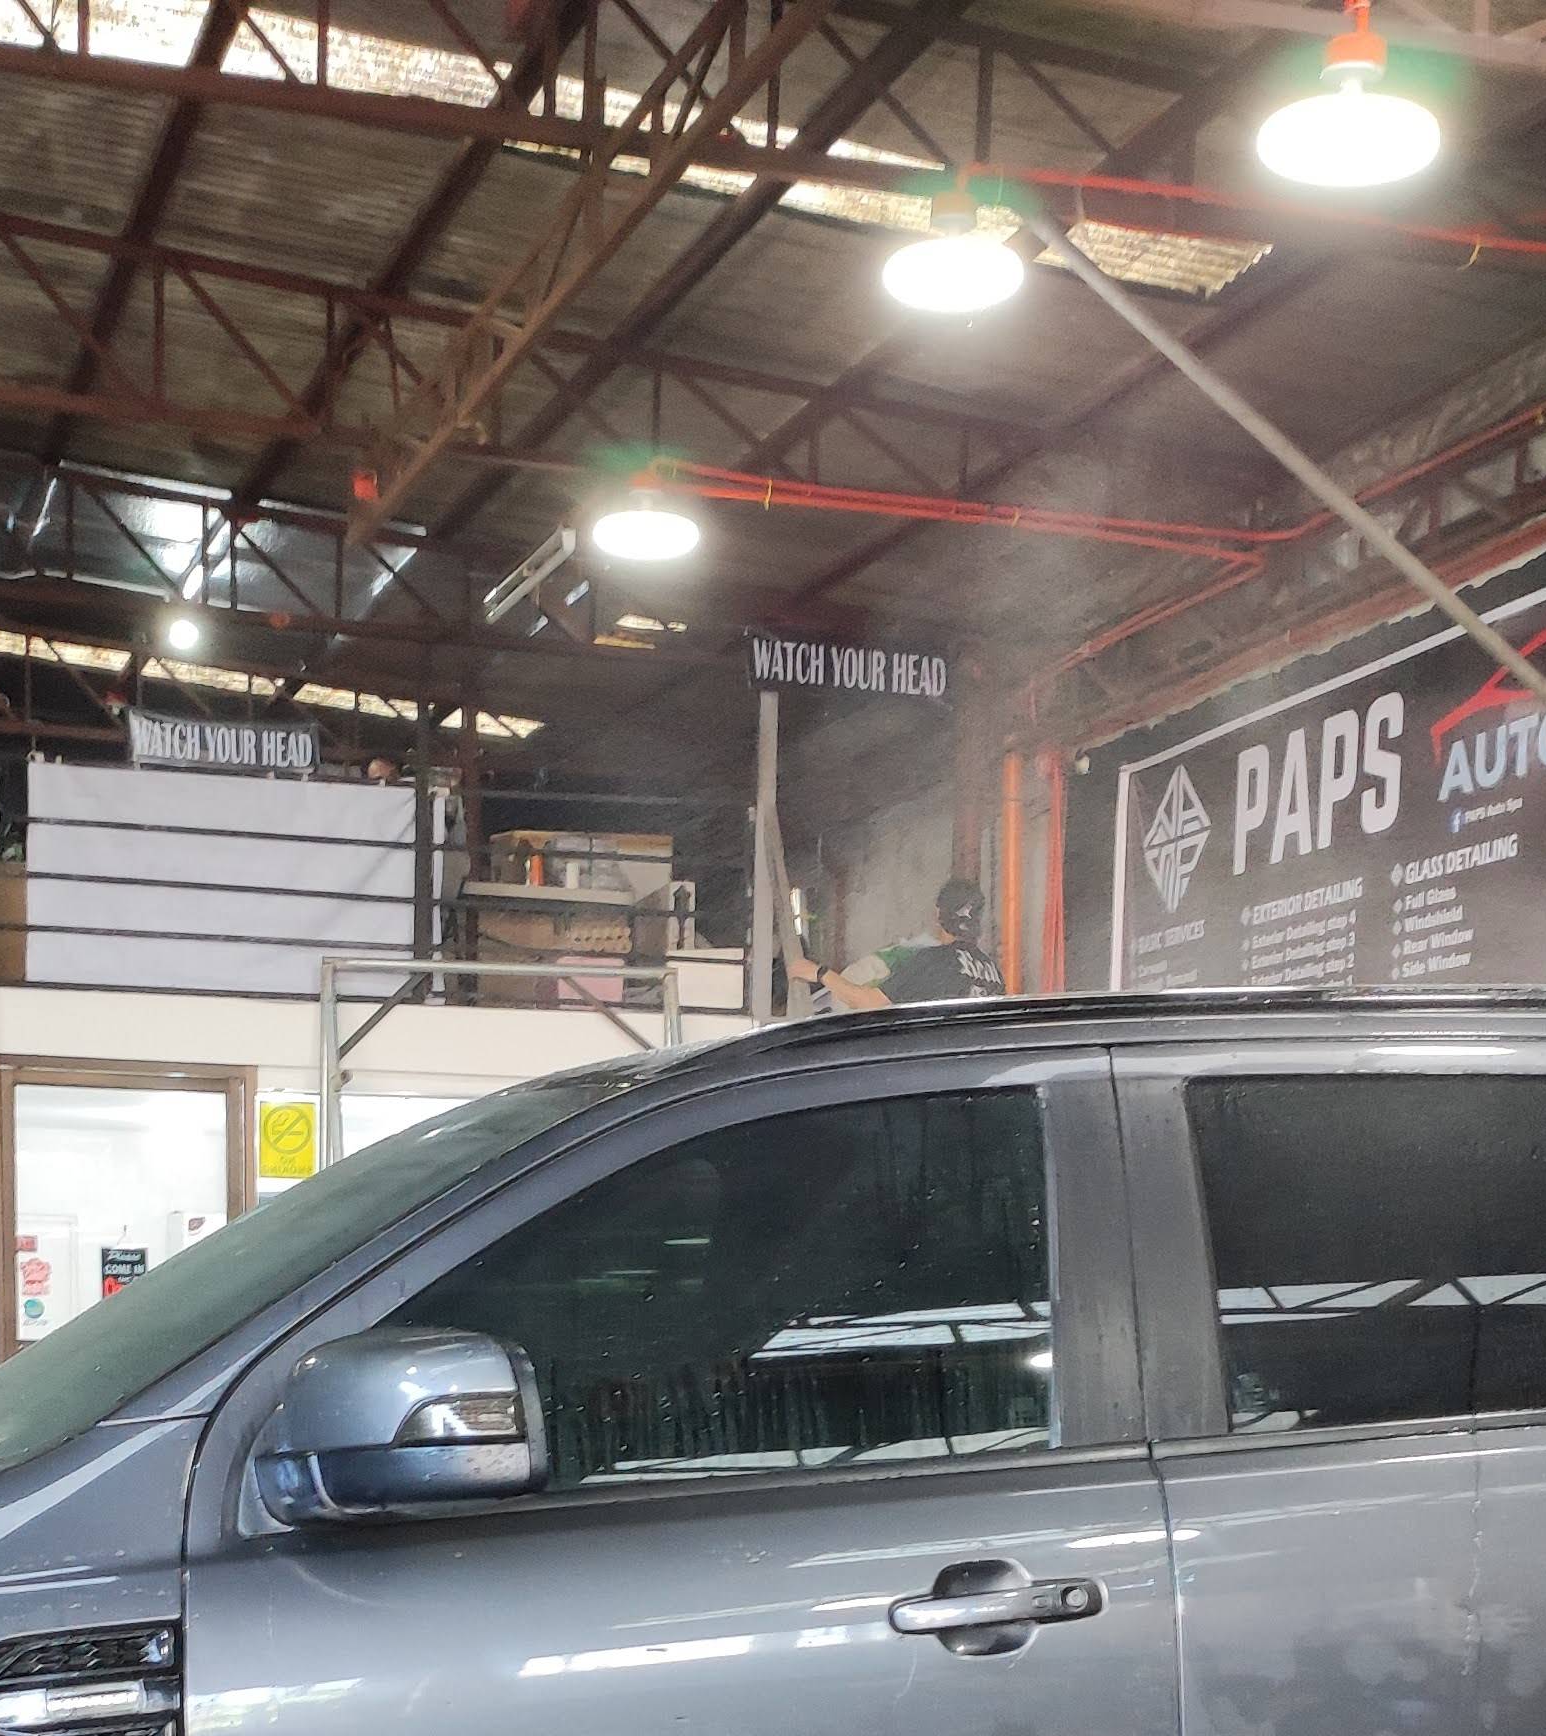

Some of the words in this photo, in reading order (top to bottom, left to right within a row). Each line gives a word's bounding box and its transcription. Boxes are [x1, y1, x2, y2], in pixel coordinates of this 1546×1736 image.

[753, 637, 825, 685] WATCH
[831, 646, 886, 692] YOUR
[891, 653, 947, 697] HEAD
[131, 718, 201, 761] WATCH
[205, 726, 257, 765] YOUR
[261, 730, 313, 768] HEAD
[1232, 692, 1405, 876] PAPS
[1405, 853, 1444, 885] GLASS
[1445, 832, 1519, 874] DETAILING
